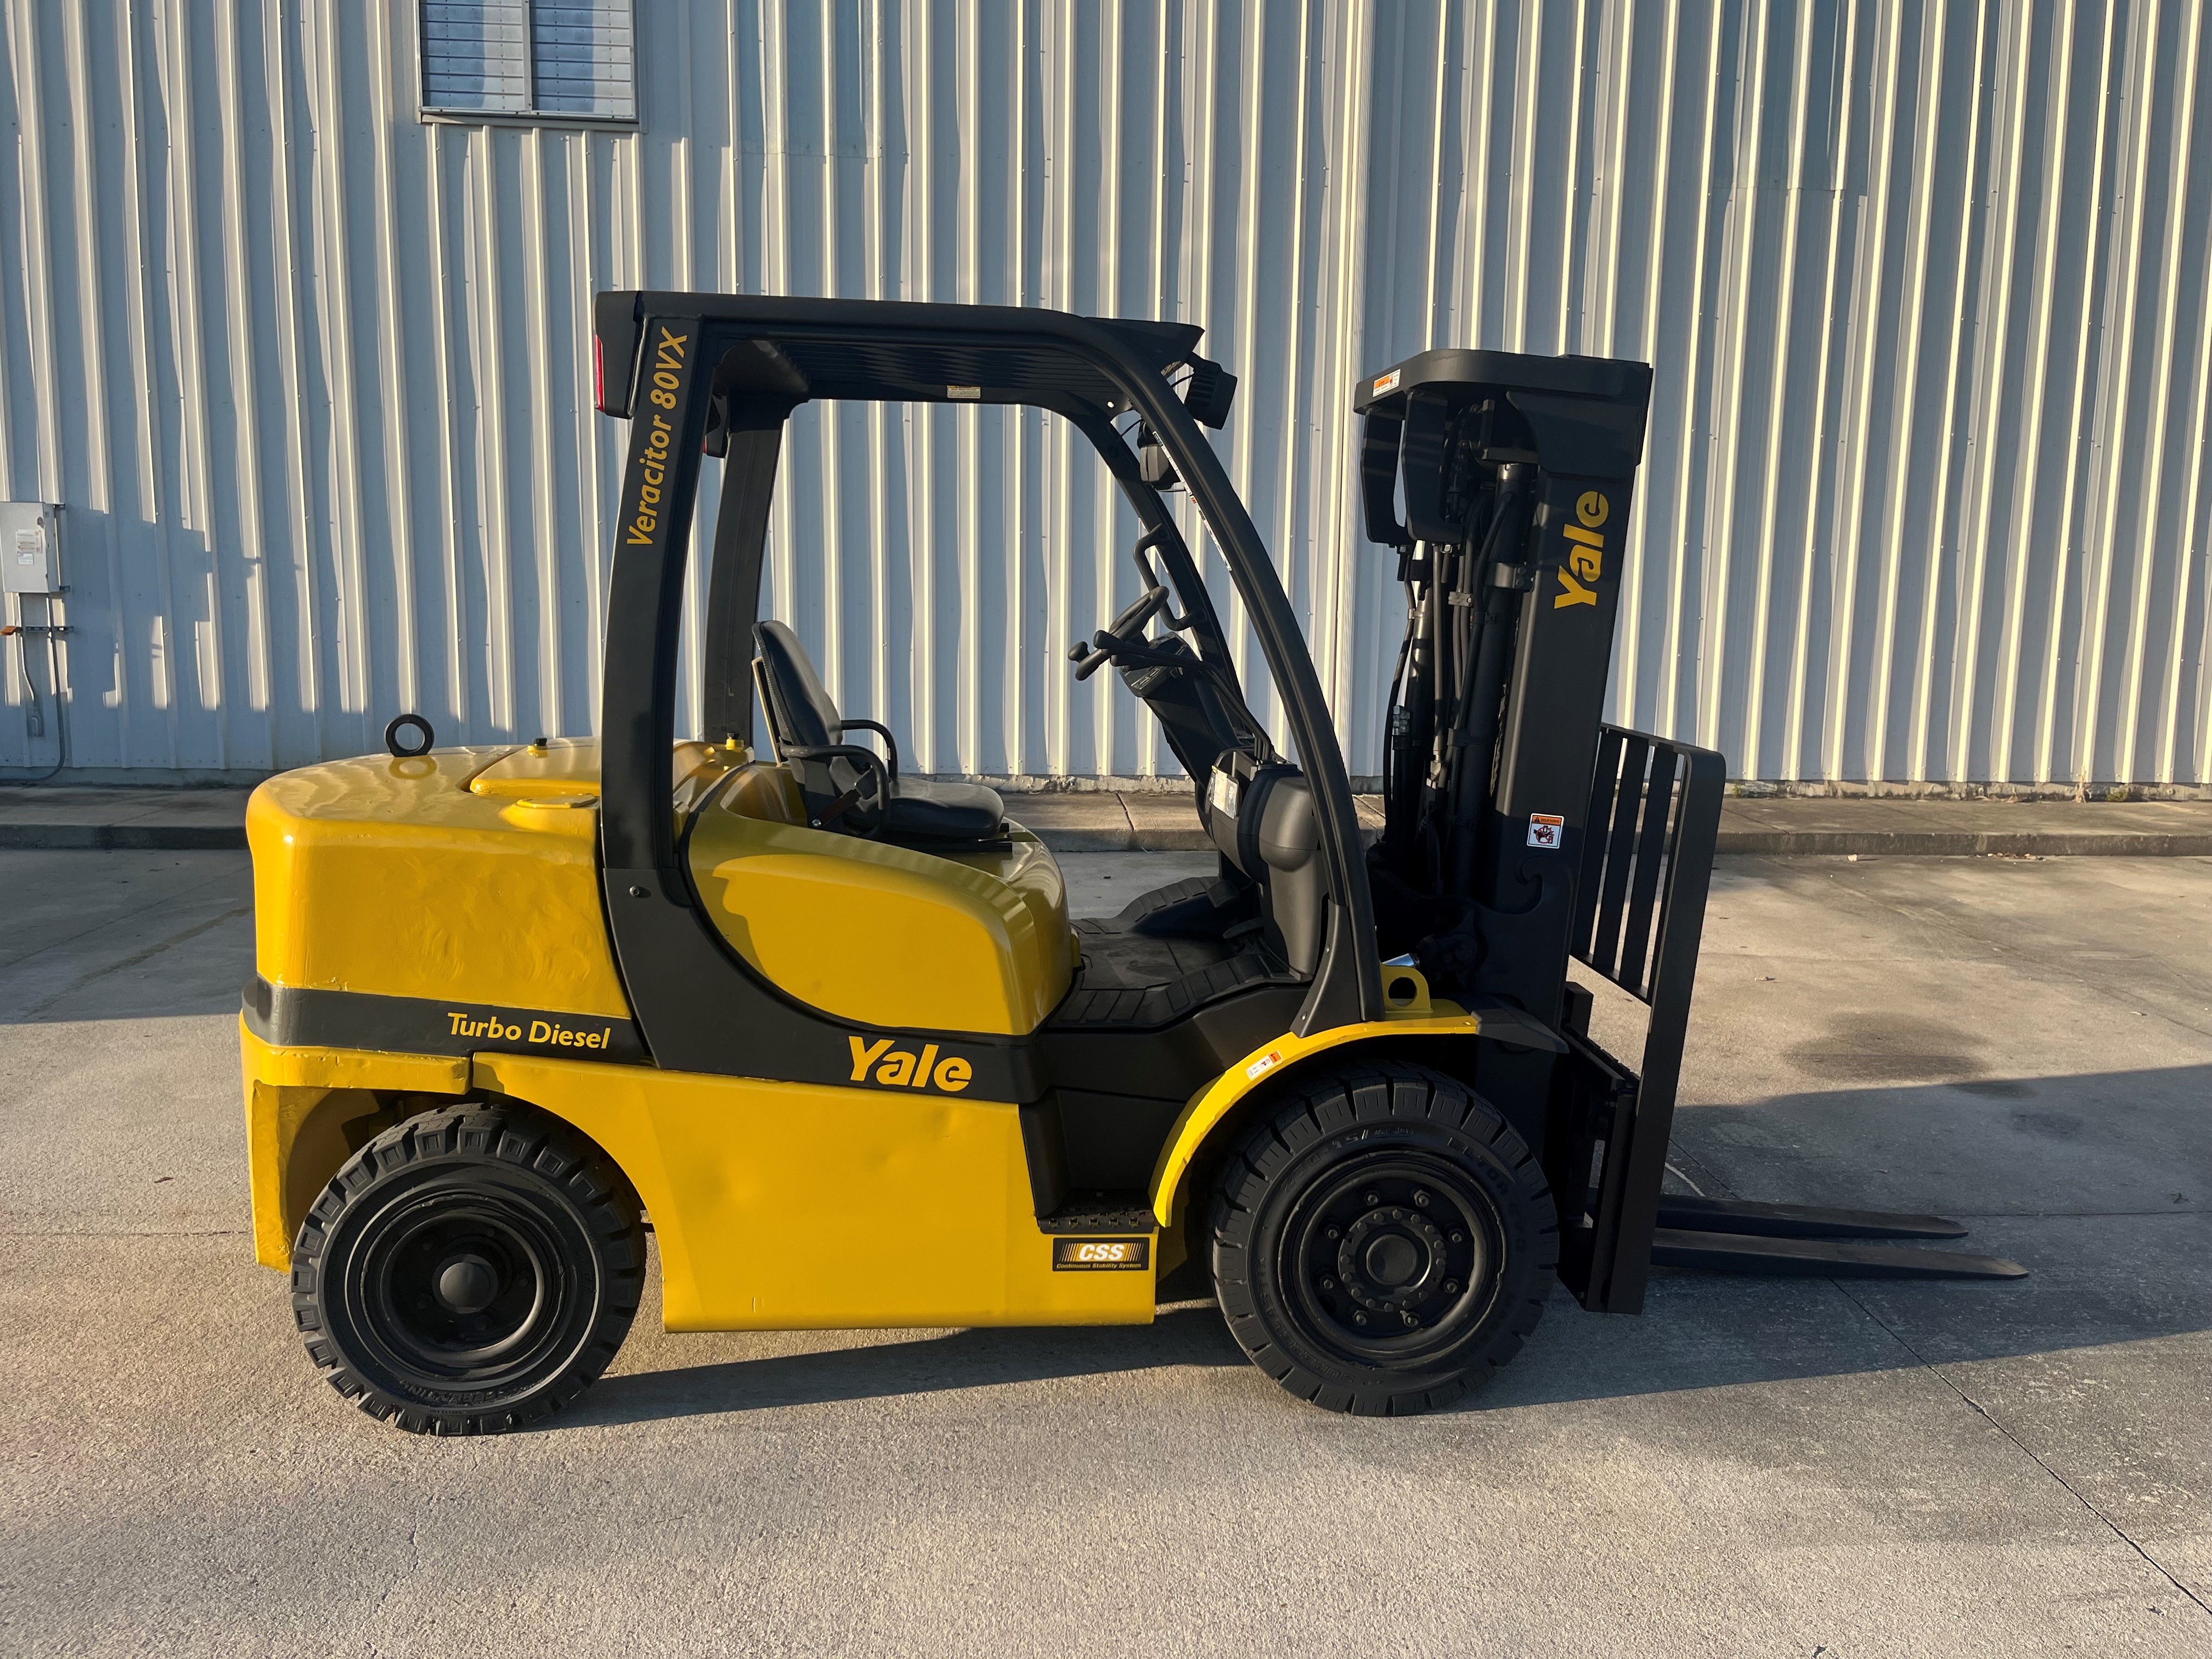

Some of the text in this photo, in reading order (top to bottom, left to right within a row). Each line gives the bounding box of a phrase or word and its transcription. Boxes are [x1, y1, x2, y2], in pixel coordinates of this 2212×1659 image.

[627, 325, 687, 545] Veracitor 80VX
[1554, 490, 1609, 610] Yale
[447, 1012, 611, 1049] Turbo Diesel
[848, 1035, 973, 1092] Yale
[1079, 1243, 1125, 1261] CSS
